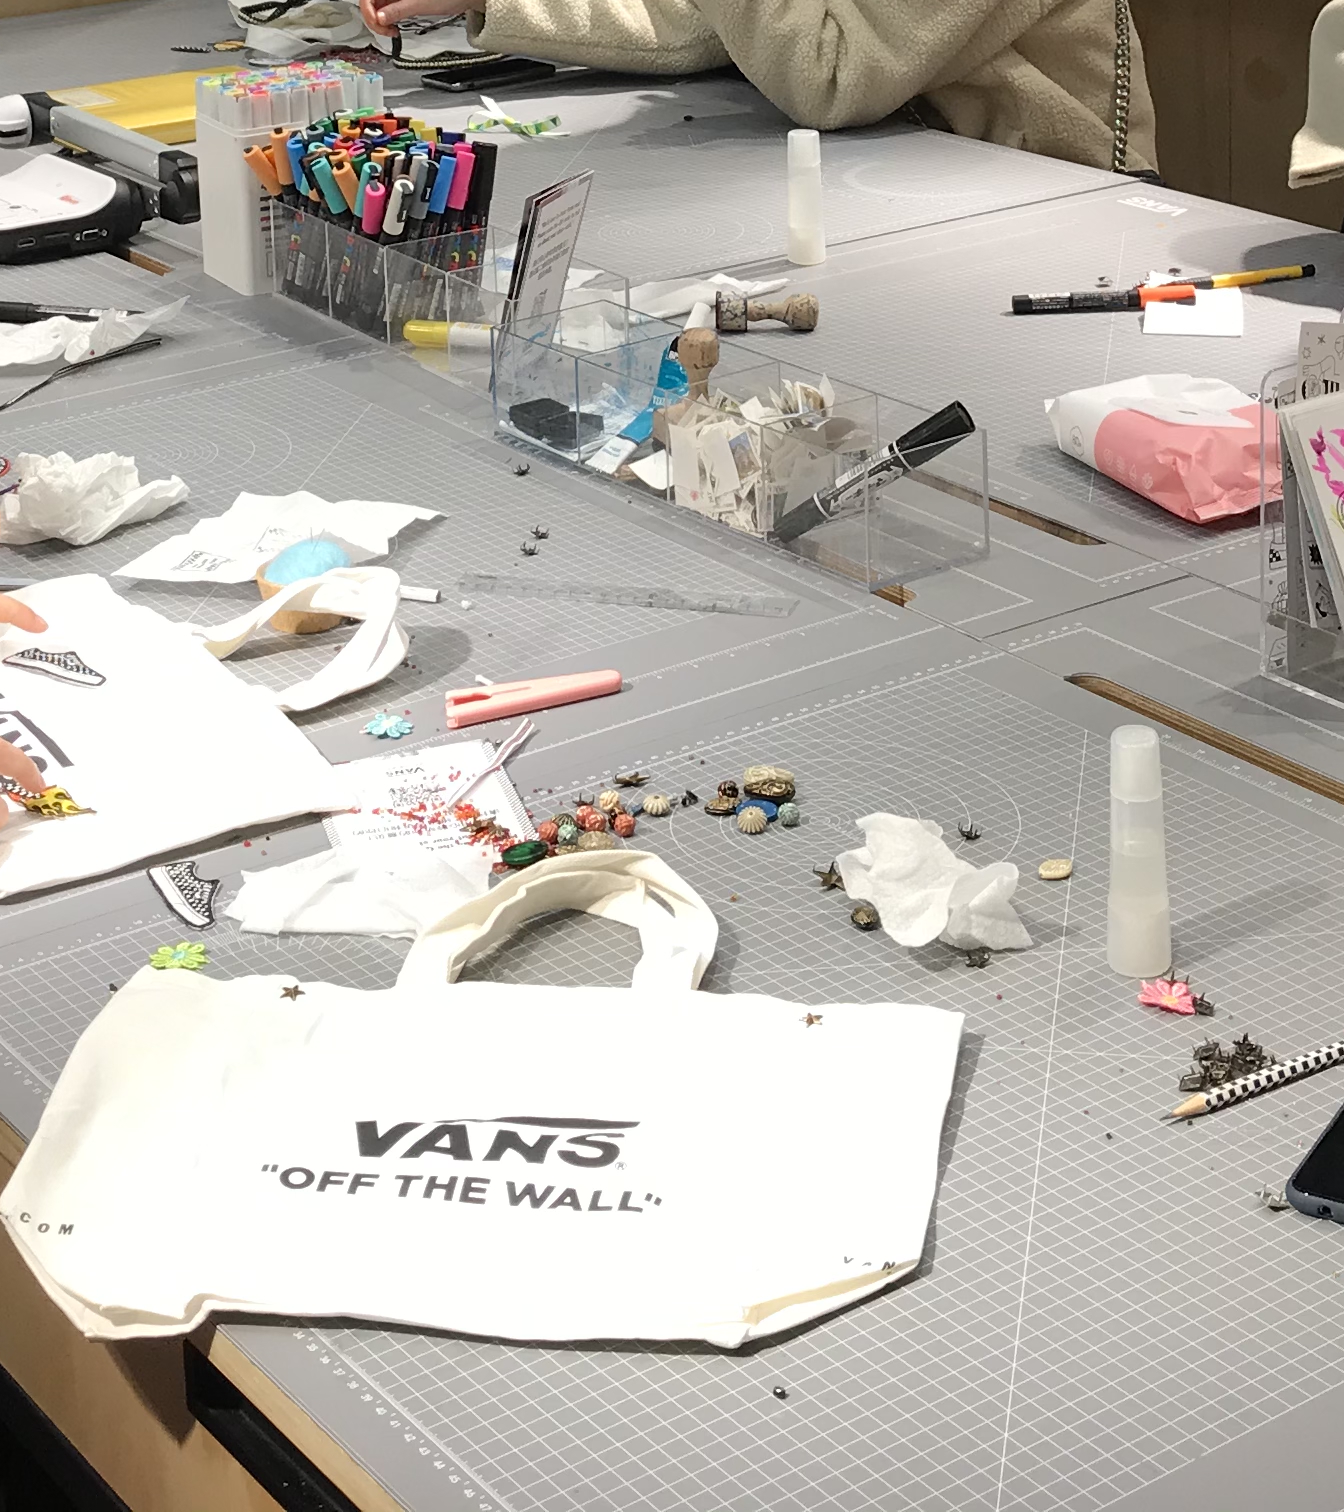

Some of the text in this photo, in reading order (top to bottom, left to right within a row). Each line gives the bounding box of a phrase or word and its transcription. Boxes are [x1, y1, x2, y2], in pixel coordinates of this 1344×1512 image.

[1116, 196, 1188, 217] VANS
[353, 1115, 641, 1170] VANS
[260, 1164, 663, 1216] "OFF THE WALL"
[293, 1331, 305, 1340] 34
[307, 1343, 318, 1351] 35
[333, 1368, 345, 1377] 37
[347, 1381, 359, 1390] 38
[361, 1393, 373, 1402] 39
[375, 1407, 388, 1416] 40
[389, 1420, 401, 1428] 41
[404, 1433, 416, 1443] 42
[419, 1447, 432, 1456] 43
[433, 1460, 446, 1470] 44
[448, 1474, 461, 1484] 45
[463, 1489, 475, 1498] 46
[479, 1503, 492, 1512] 47
